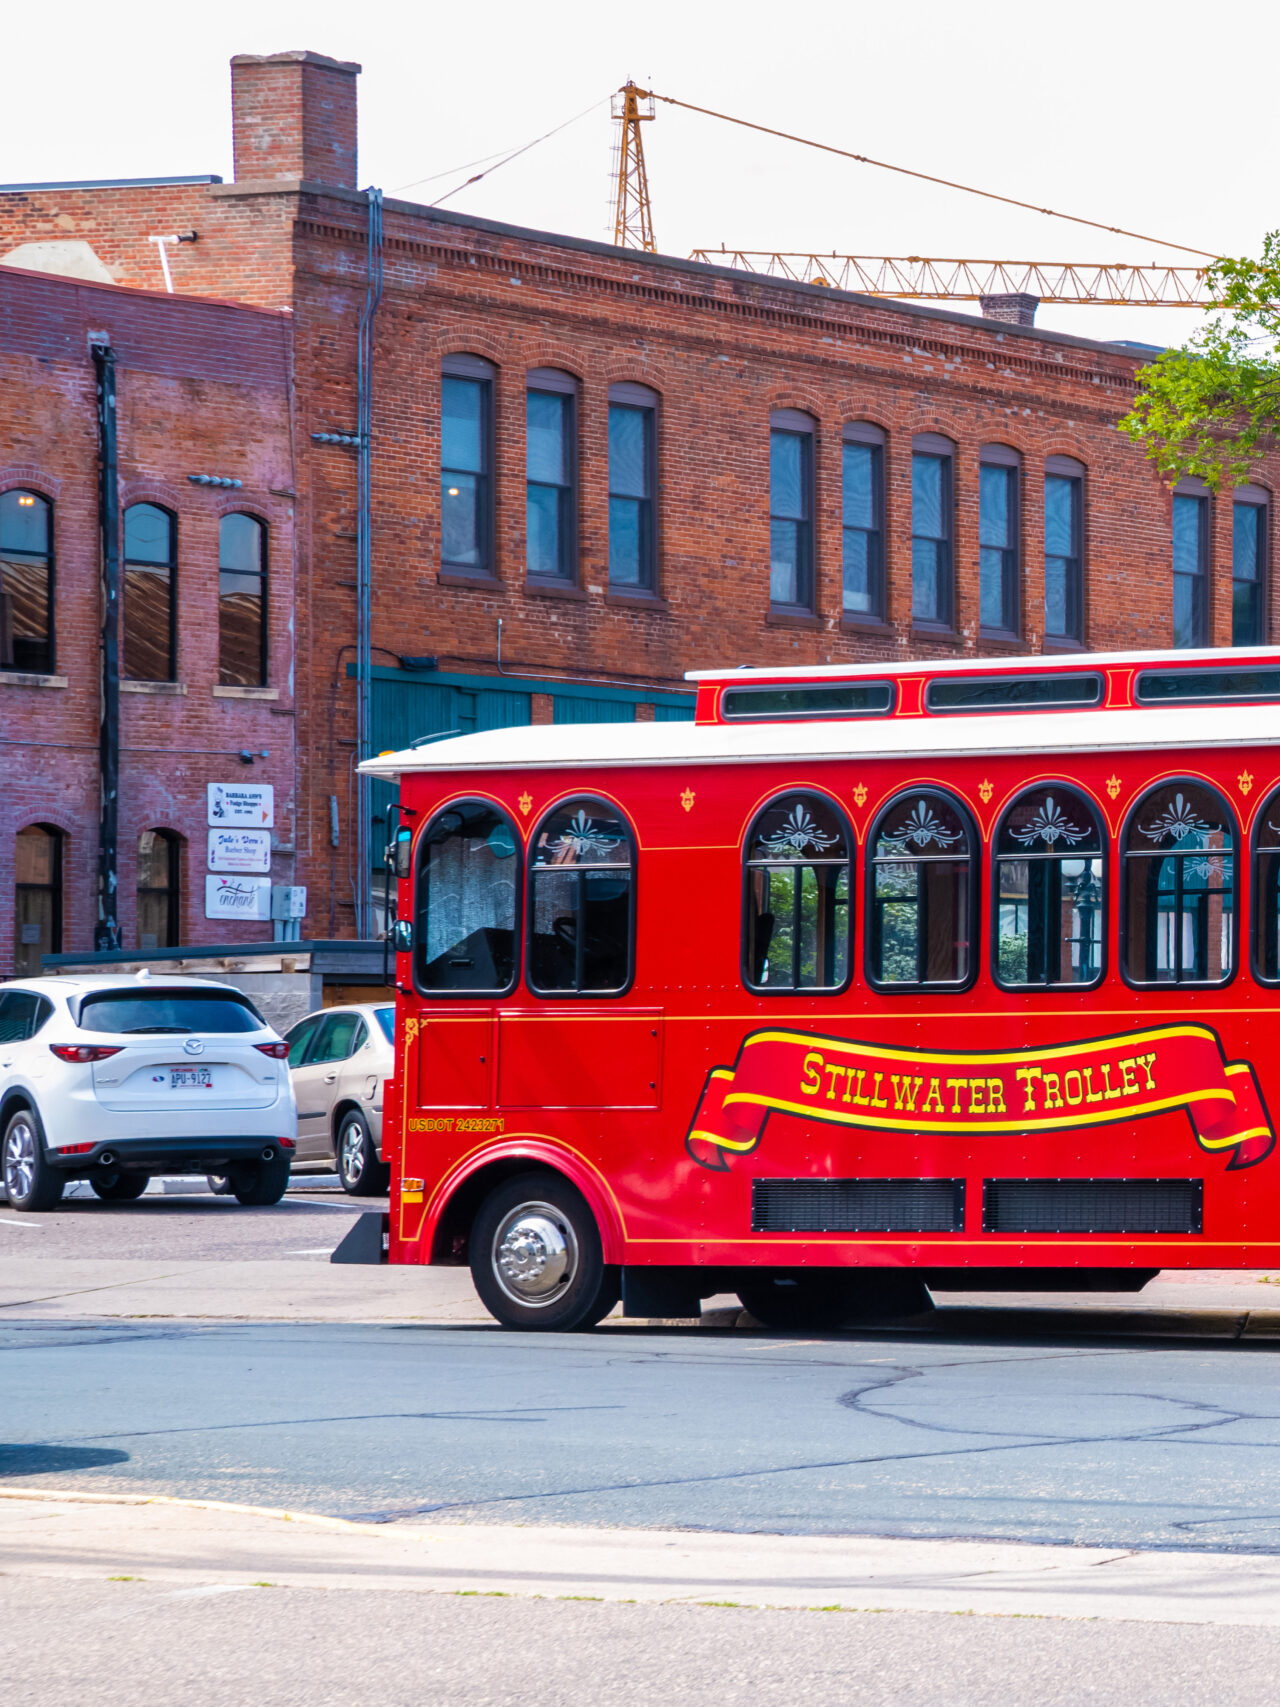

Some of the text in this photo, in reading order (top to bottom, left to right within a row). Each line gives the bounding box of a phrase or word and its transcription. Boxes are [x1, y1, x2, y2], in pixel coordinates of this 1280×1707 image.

[171, 1072, 212, 1084] APU-9127
[800, 1051, 1157, 1114] STILLWATER TROLLEY
[408, 1118, 504, 1132] USDOT 2423271
